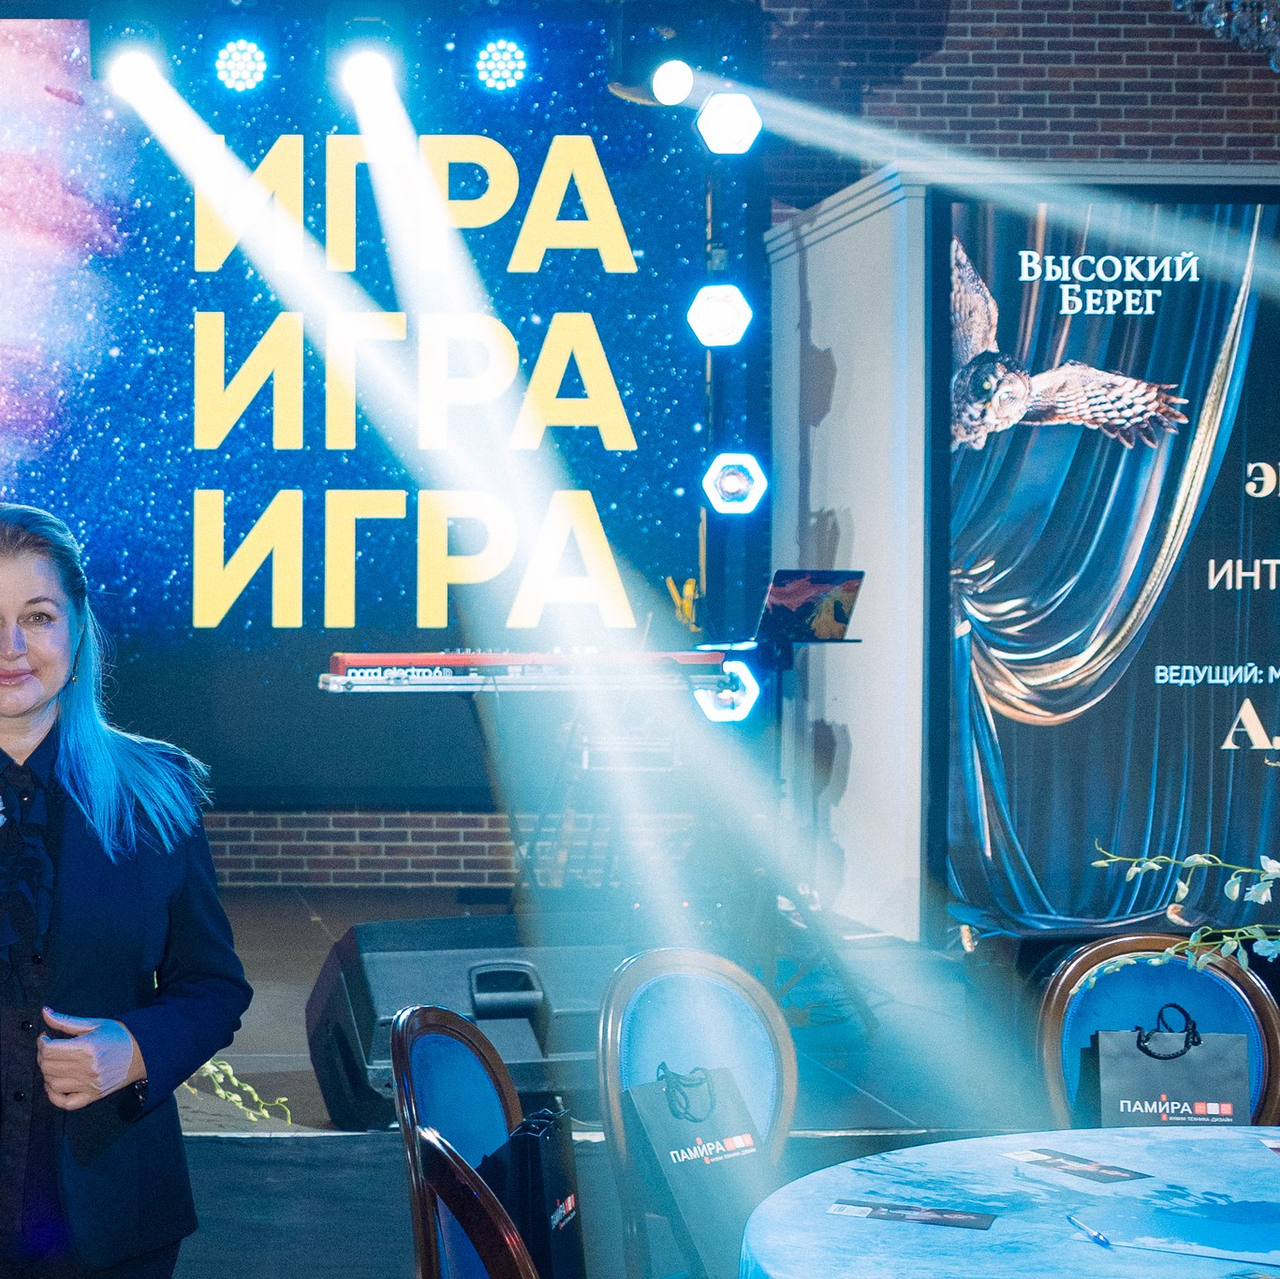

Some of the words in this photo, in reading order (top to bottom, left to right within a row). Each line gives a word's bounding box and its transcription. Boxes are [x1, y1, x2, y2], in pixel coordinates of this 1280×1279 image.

[193, 134, 638, 274] ИГРА
[193, 310, 638, 451] ИГРА
[192, 489, 637, 629] ИГРА
[1153, 662, 1265, 687] ВЕДУЩИЙ:
[1119, 1099, 1193, 1115] ПАМИРА
[669, 1140, 727, 1164] ПАМИРА
